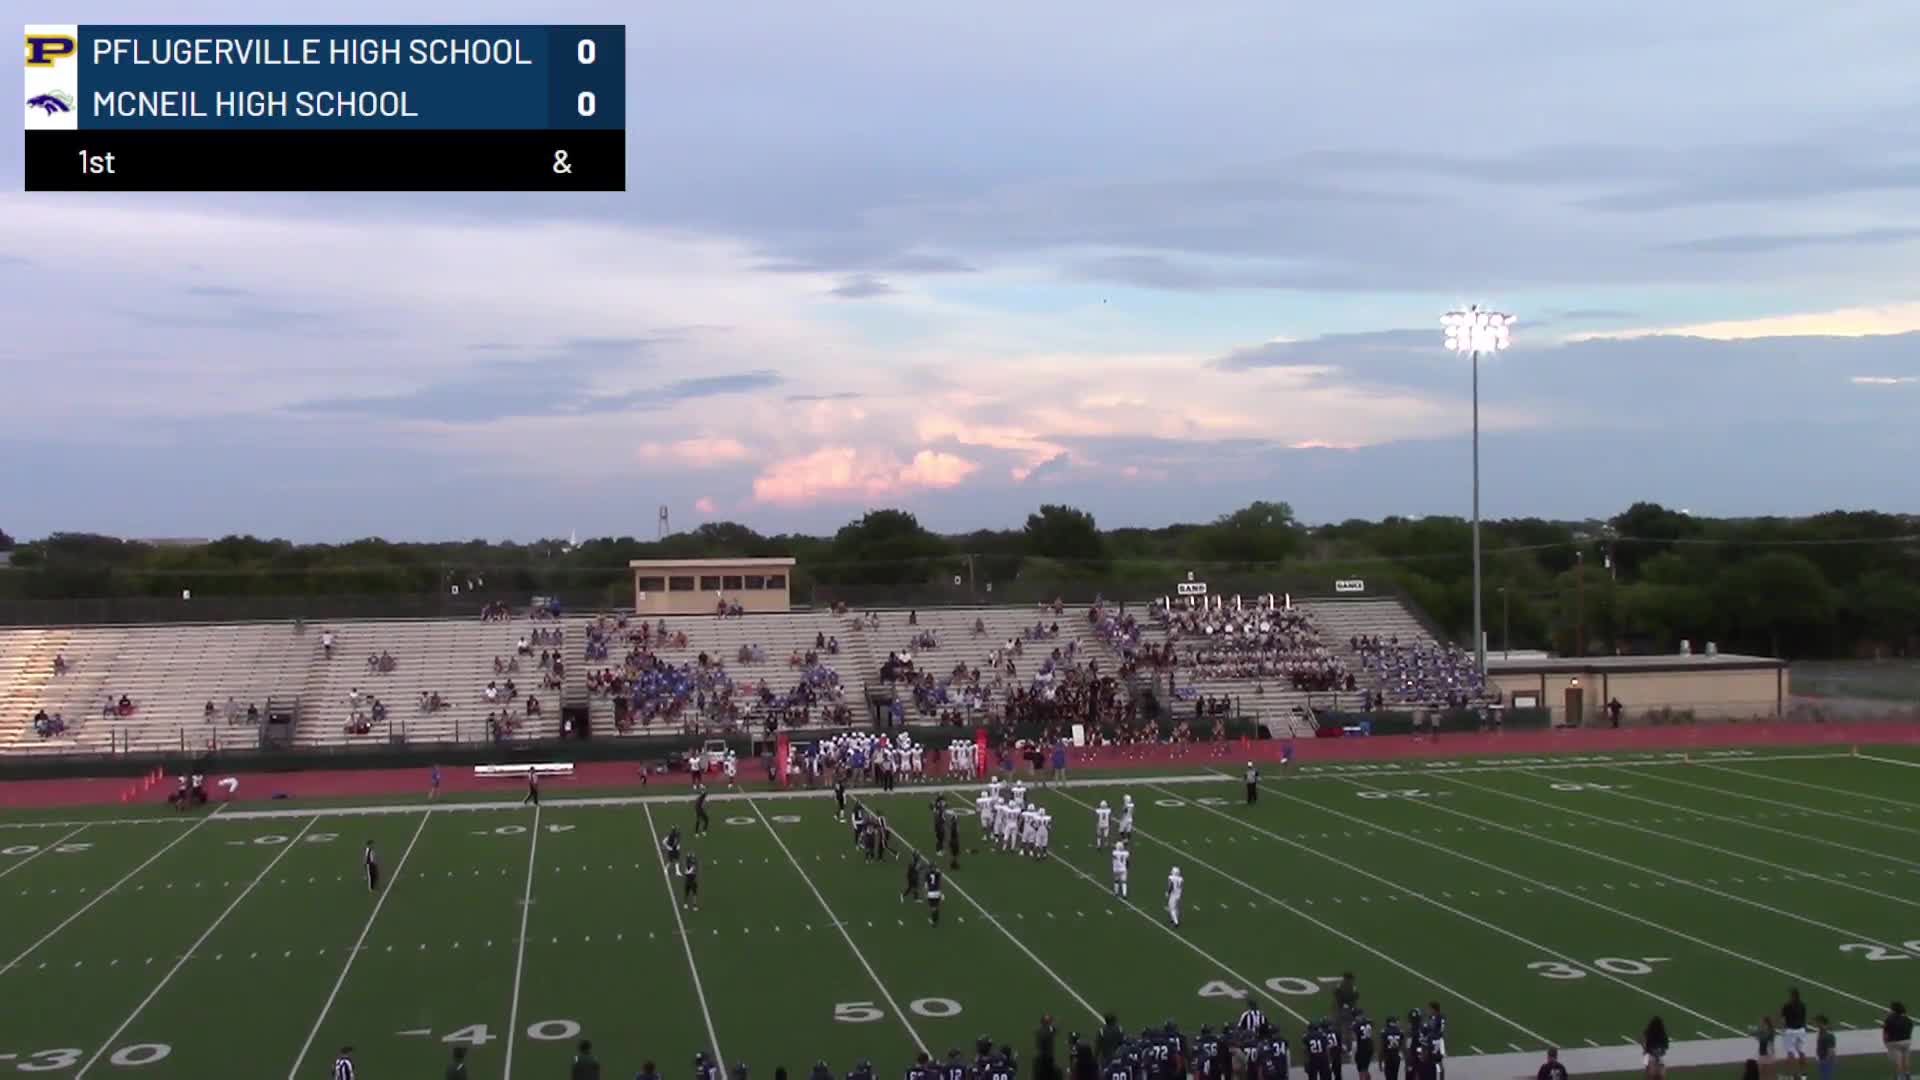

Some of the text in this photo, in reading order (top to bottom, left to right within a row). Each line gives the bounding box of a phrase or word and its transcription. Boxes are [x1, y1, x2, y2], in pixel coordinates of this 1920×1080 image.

[1526, 957, 1653, 979] 30
[1197, 976, 1321, 999] 40
[834, 997, 963, 1022] 50
[441, 1019, 581, 1046] 40
[16, 1043, 173, 1072] 30
[1309, 1039, 1323, 1053] 21
